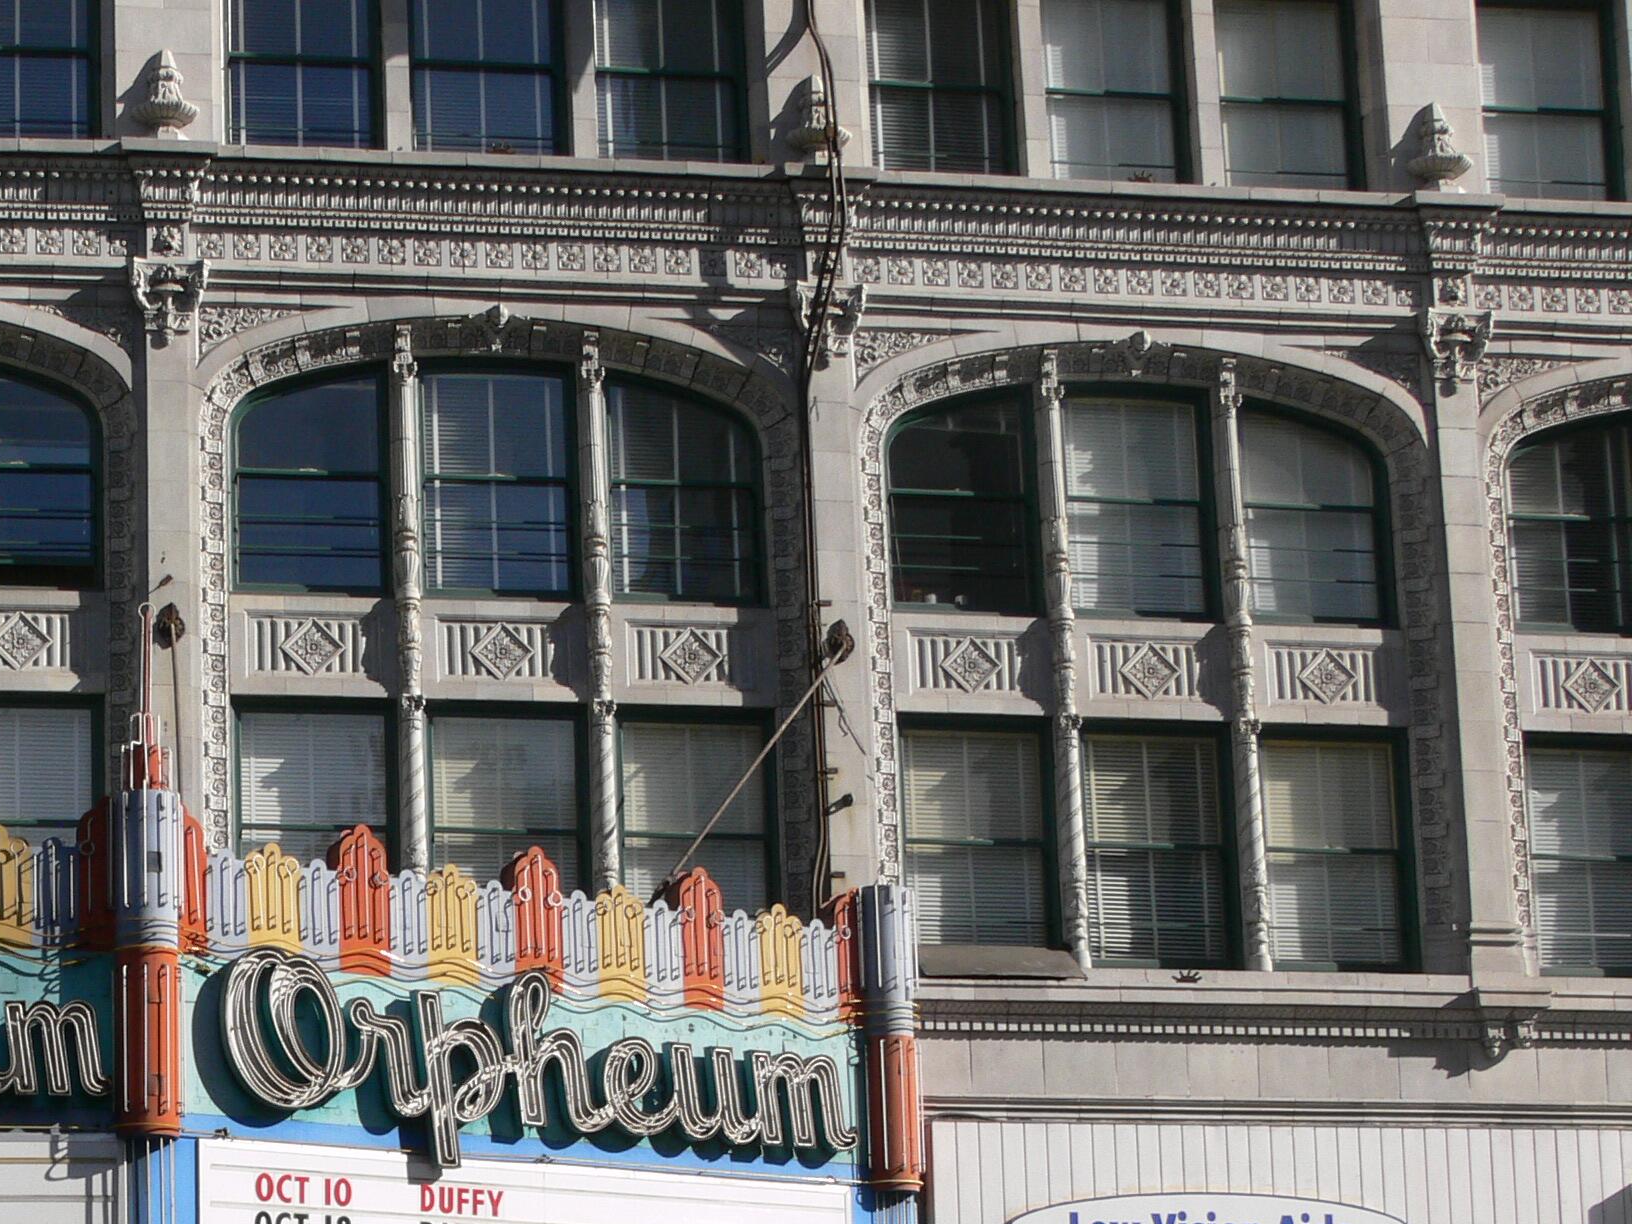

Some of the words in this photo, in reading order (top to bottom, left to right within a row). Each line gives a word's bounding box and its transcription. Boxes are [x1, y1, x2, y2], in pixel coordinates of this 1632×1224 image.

[220, 948, 858, 1169] Orpheum
[255, 1173, 310, 1204] OCT
[324, 1178, 352, 1207] 10
[420, 1184, 504, 1217] DUFFY
